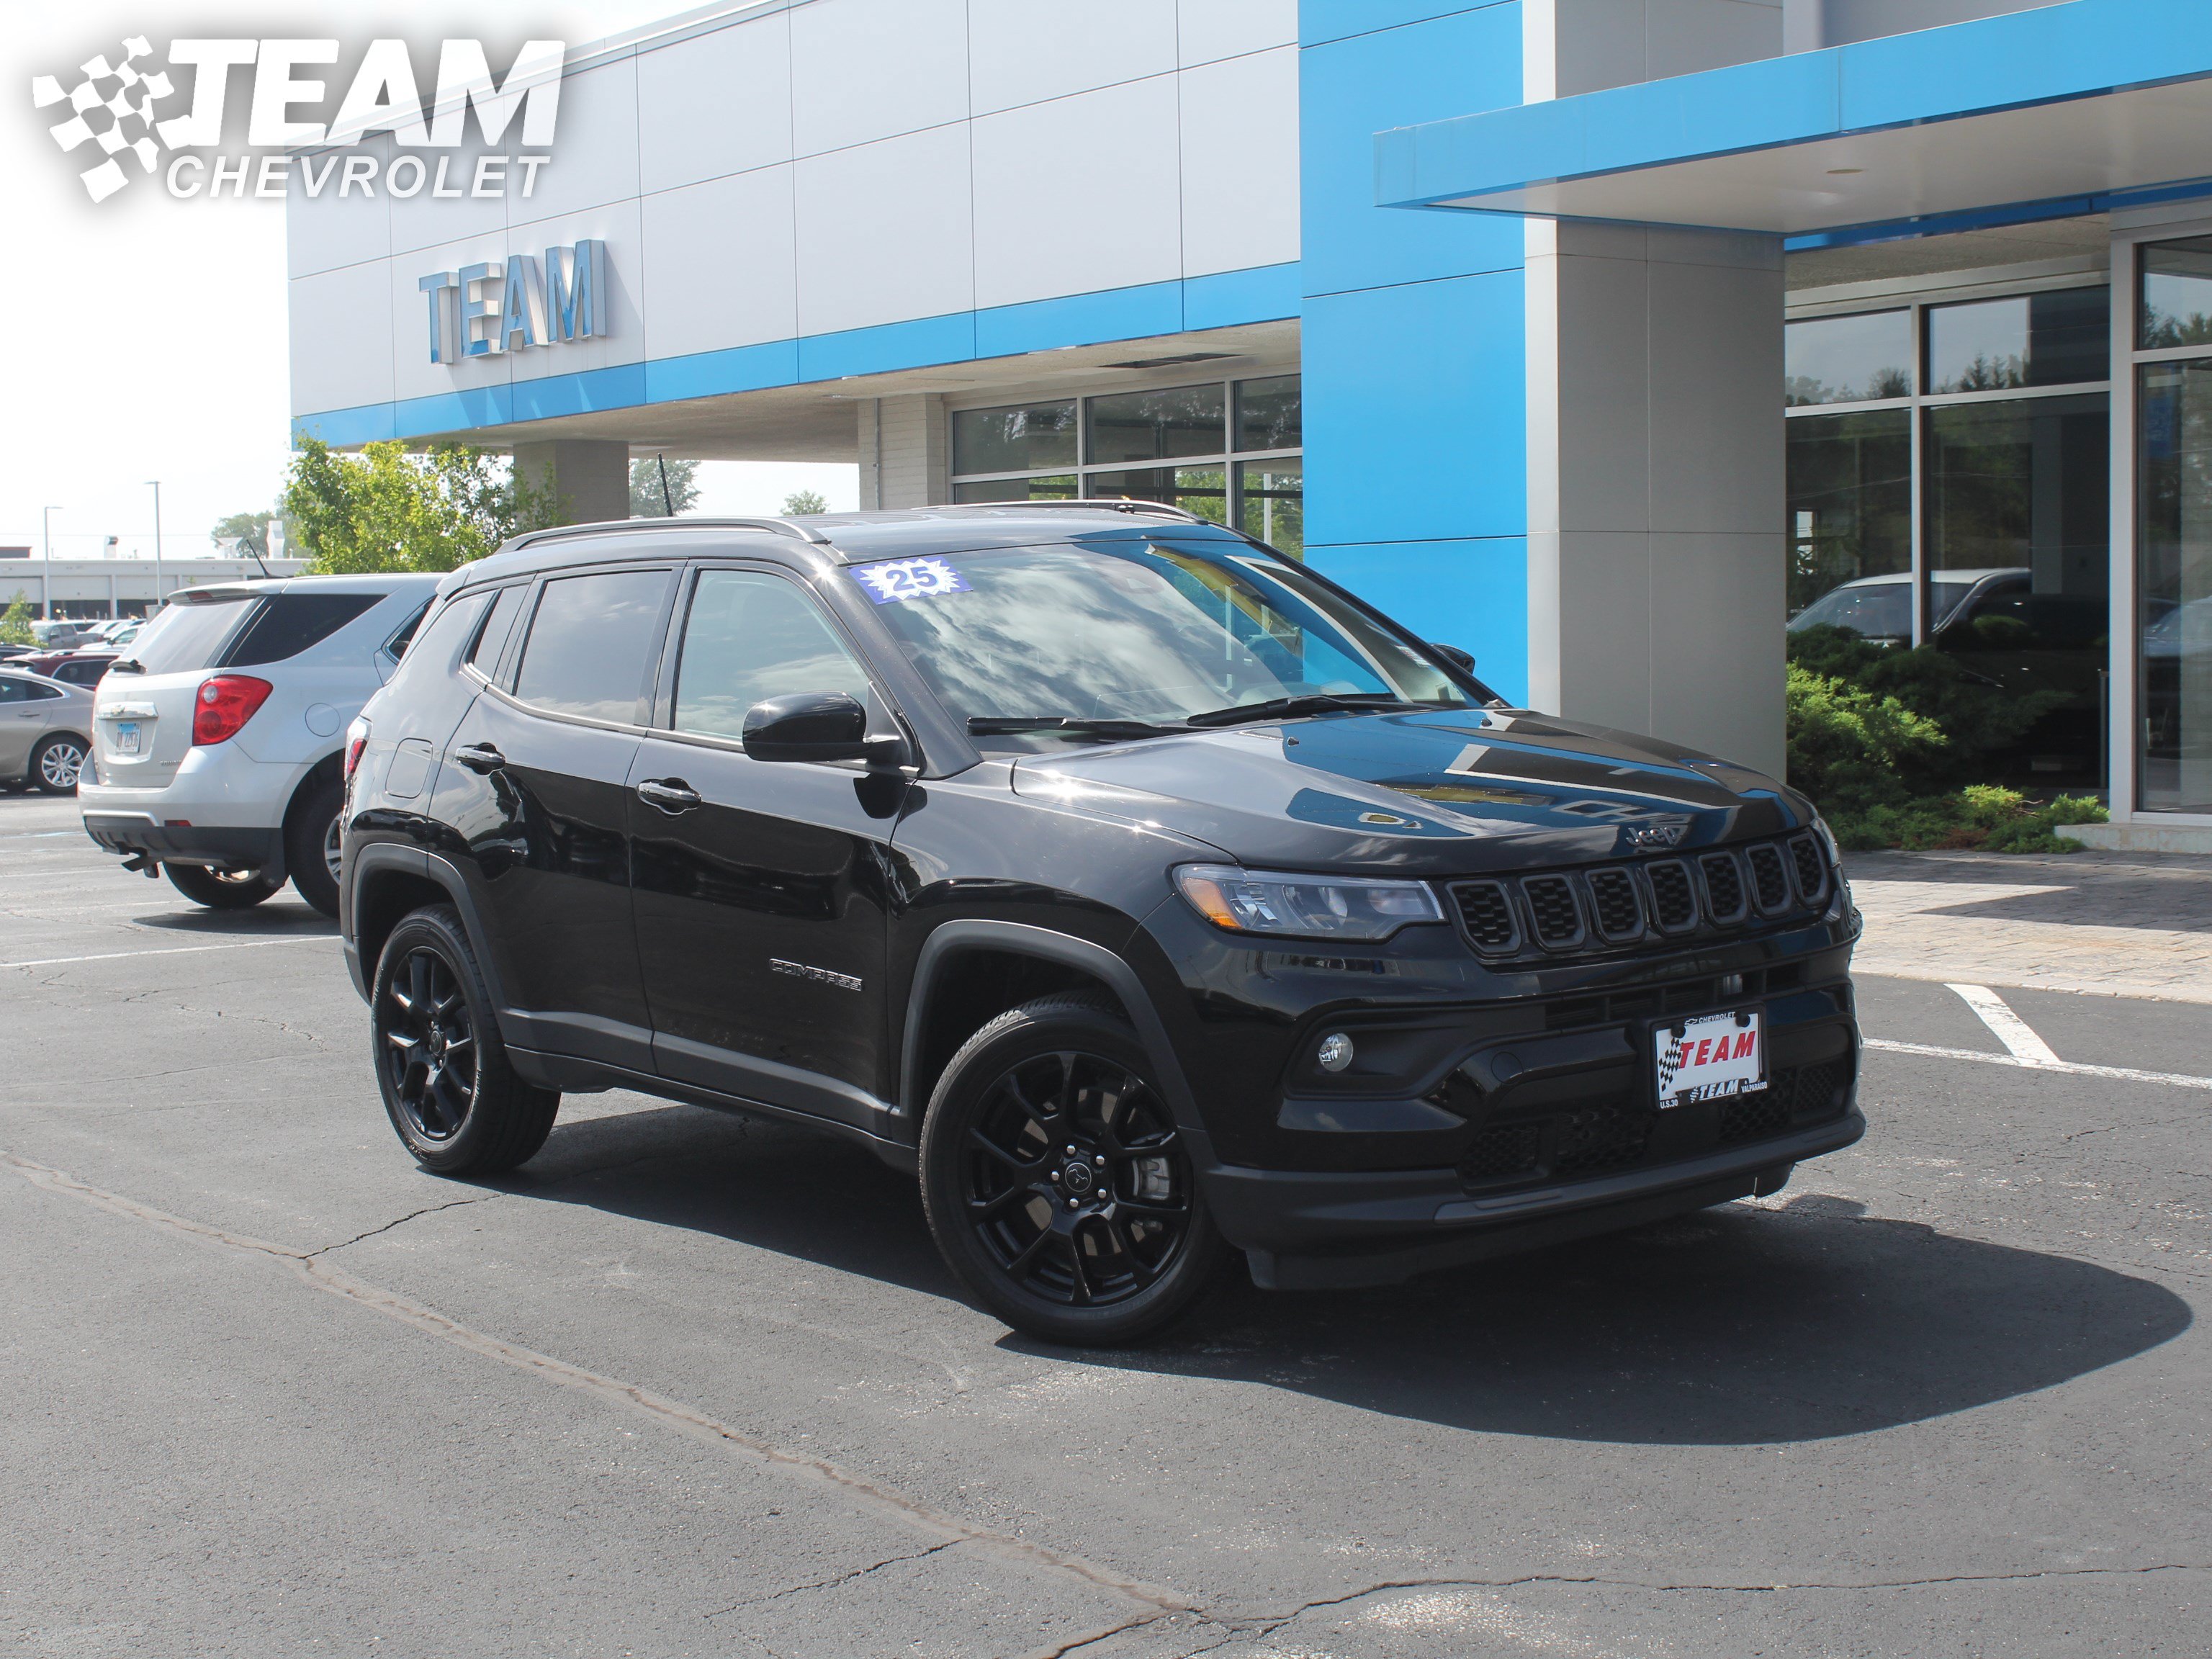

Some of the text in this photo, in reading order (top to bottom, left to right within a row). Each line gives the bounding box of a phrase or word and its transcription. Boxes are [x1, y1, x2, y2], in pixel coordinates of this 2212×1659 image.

[418, 239, 606, 364] TEAM
[885, 566, 938, 592] 25
[1626, 827, 1678, 847] Jeep
[769, 958, 863, 992] COMPASS
[1699, 1011, 1736, 1024] CHEVROLET
[1678, 1030, 1756, 1069] TEAM
[1699, 1079, 1739, 1100] TEAM
[1741, 1081, 1768, 1093] VALPARAISO
